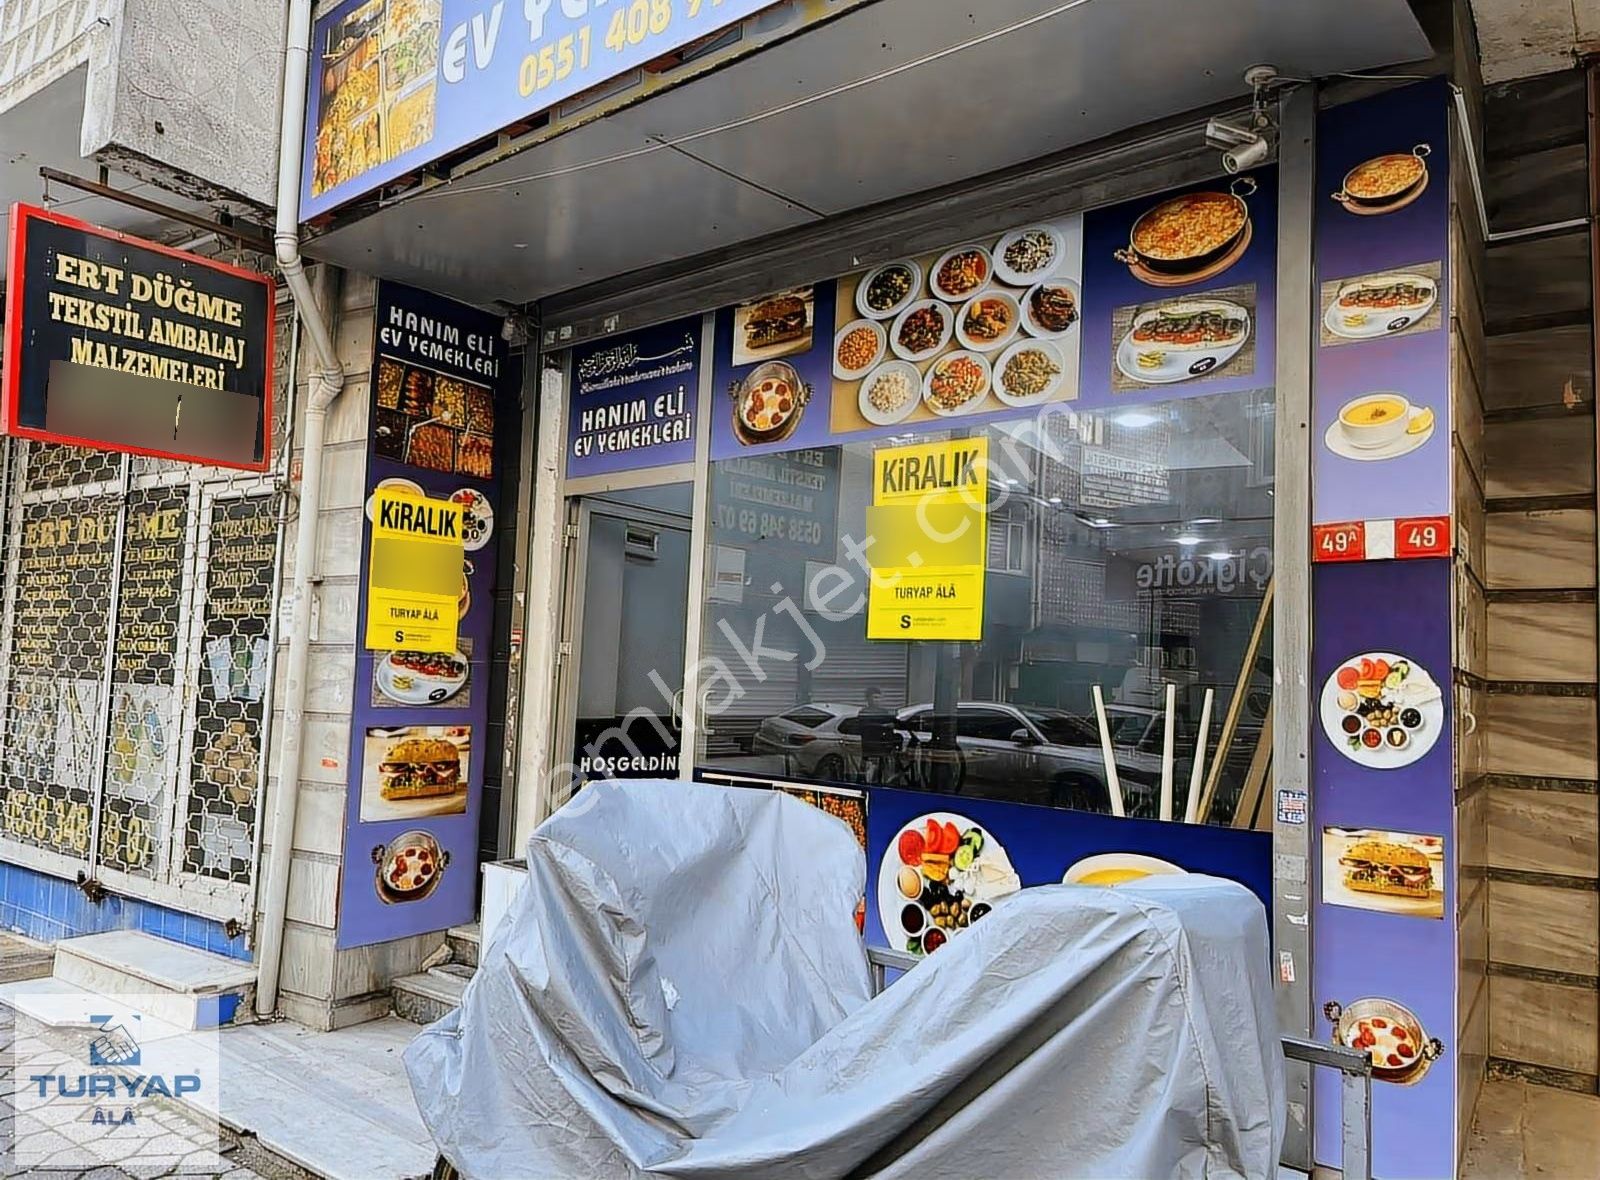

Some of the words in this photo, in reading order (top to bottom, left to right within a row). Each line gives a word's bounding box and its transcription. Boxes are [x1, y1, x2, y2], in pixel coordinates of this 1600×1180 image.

[442, 2, 505, 84] EV
[518, 25, 592, 98] 0551
[604, 0, 672, 52] 408
[55, 253, 124, 295] ERT
[130, 273, 242, 328] DÜĞME
[49, 291, 144, 340] TEKSTİL
[148, 317, 245, 369] AMBALAJ
[380, 327, 402, 347] EV
[408, 335, 499, 379] YEMEKLERİ
[389, 305, 459, 346] HANIM
[467, 334, 493, 357] ELİ
[71, 337, 225, 391] MALZEMELERİ
[574, 436, 593, 457] EV
[598, 412, 691, 453] YEMEKLERİ
[582, 399, 646, 432] HANIM
[654, 385, 684, 418] ELİ
[1407, 526, 1437, 548] 49
[390, 607, 422, 619] TURYAP
[895, 587, 933, 600] TURYAP
